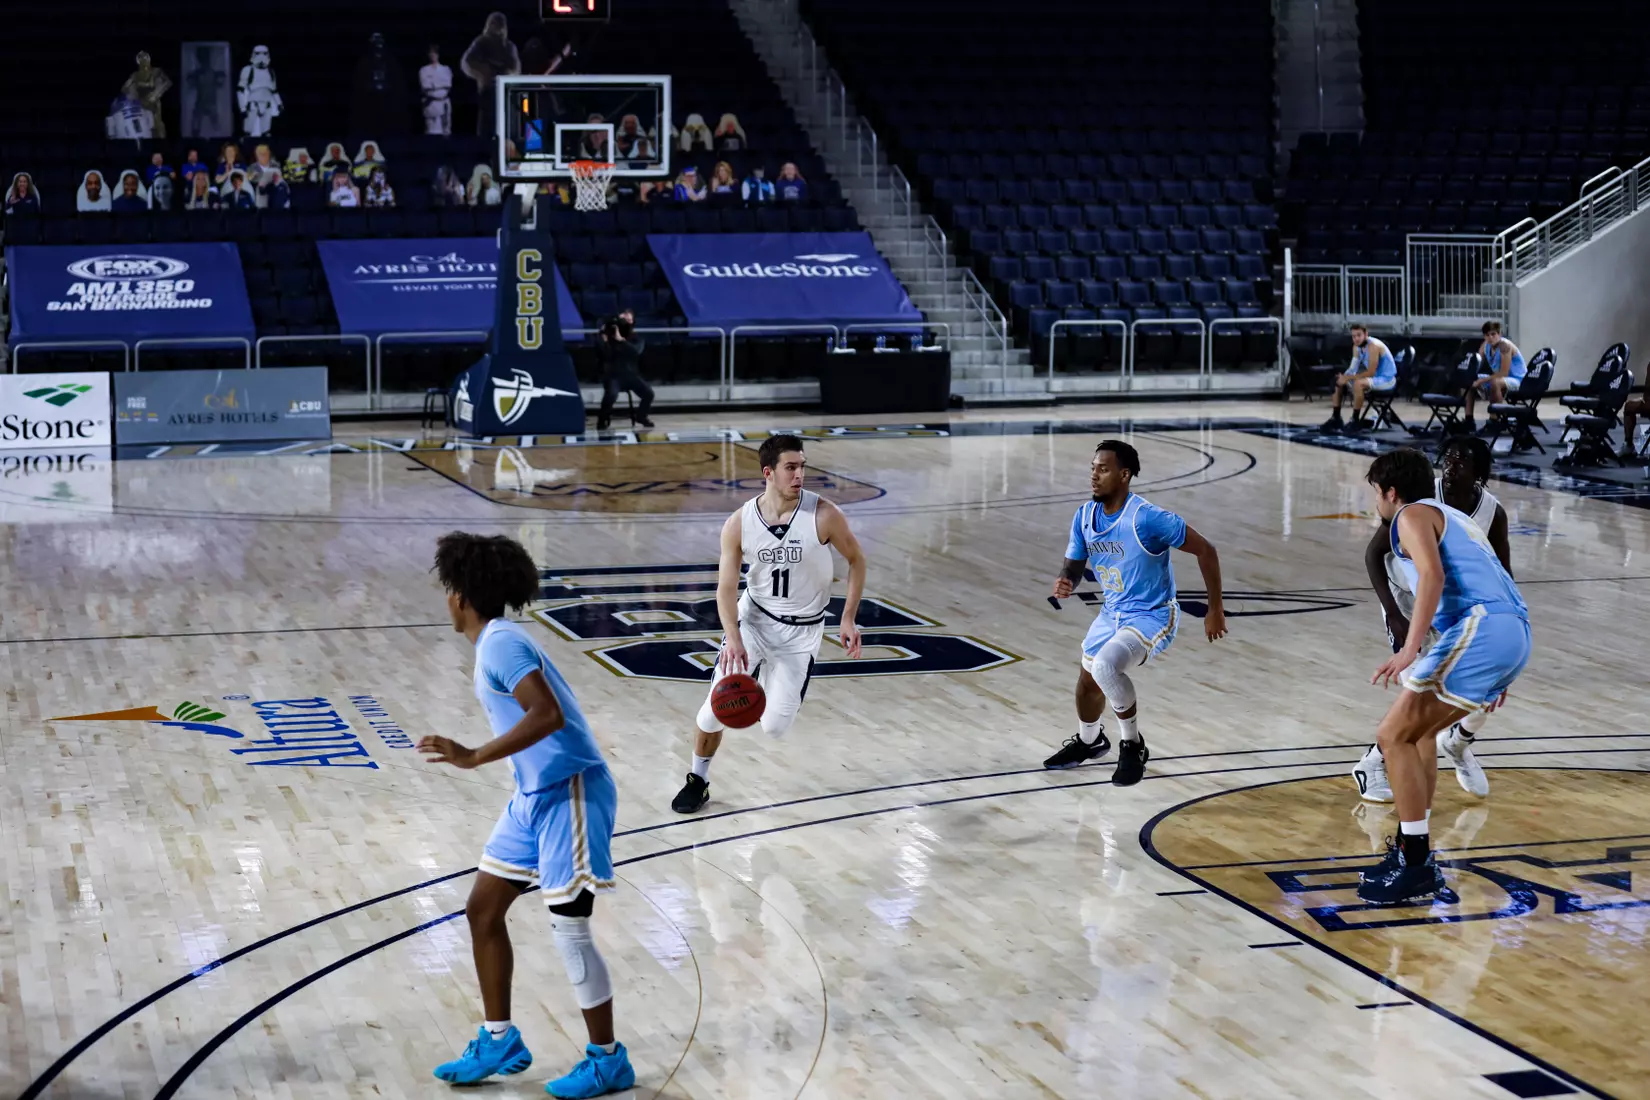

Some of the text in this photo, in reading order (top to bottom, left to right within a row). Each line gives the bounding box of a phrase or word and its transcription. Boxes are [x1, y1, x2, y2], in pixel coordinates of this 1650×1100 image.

[94, 260, 164, 276] FOX
[354, 263, 430, 274] AYRES
[683, 262, 873, 278] GuideStone
[66, 279, 195, 296] AM1350
[392, 284, 439, 292] ELEVATE
[443, 283, 473, 291] YOUR
[46, 298, 213, 312] SAN BERNARDINO
[80, 291, 178, 304] RIVERSIDE
[516, 248, 544, 349] CBU
[167, 411, 279, 425] AYRES HOTELS
[0, 413, 95, 441] Stone
[758, 546, 803, 564] CBU
[771, 568, 790, 599] 11
[1096, 564, 1125, 593] 23
[347, 695, 415, 749] CREDIT UNION
[229, 696, 380, 769] Altura
